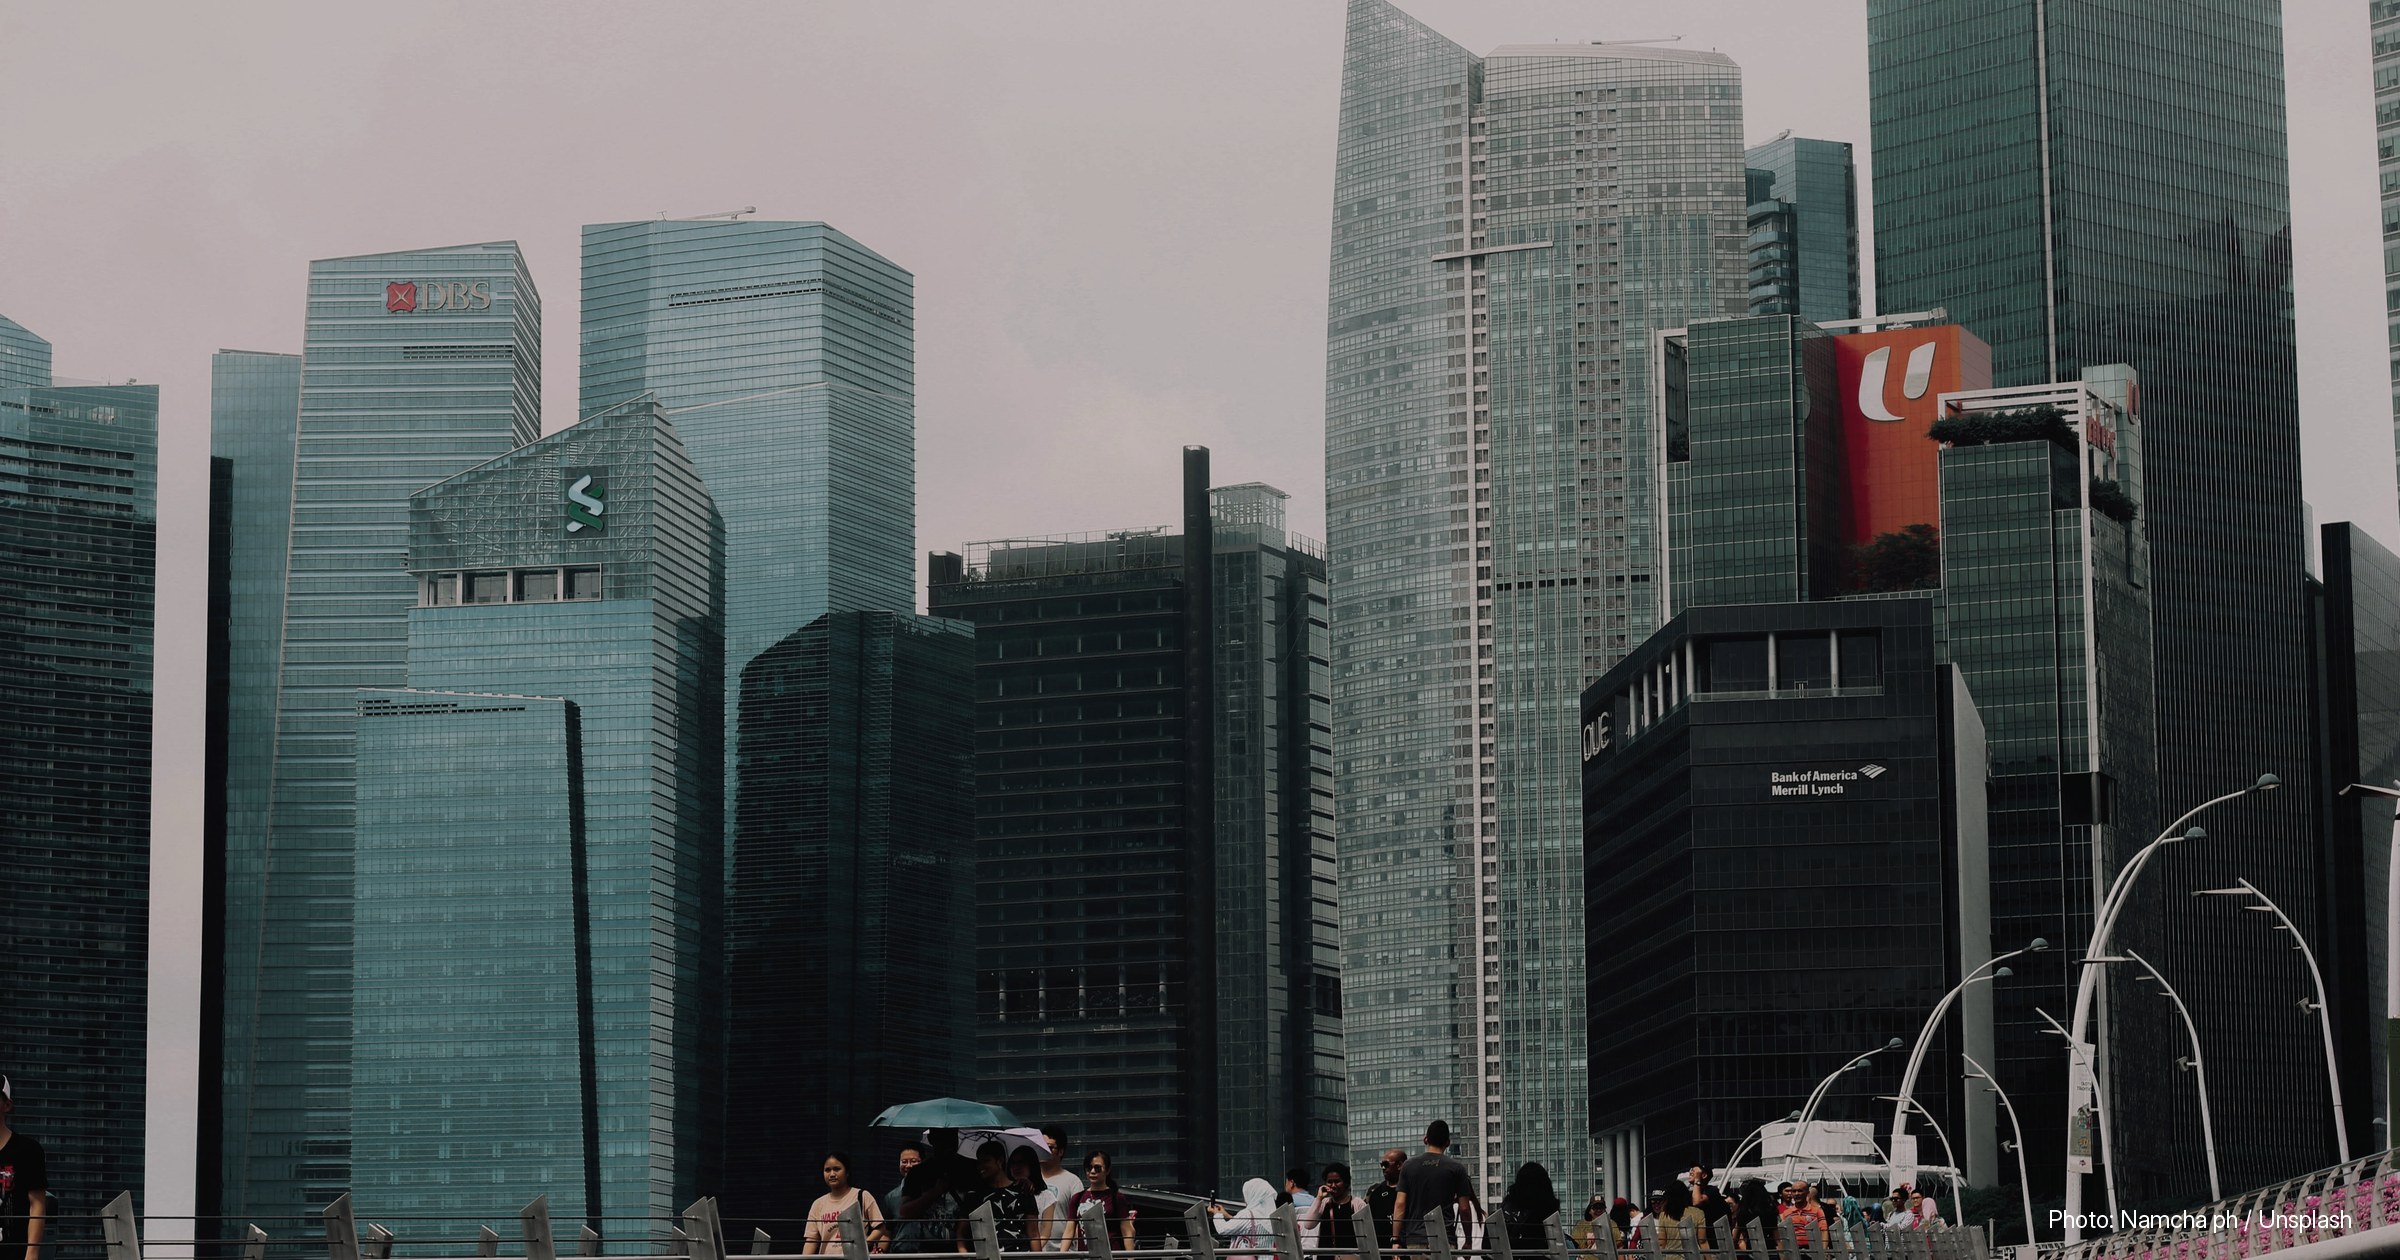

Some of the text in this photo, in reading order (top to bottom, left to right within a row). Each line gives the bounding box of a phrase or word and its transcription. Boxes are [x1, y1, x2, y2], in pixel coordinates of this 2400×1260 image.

[421, 282, 491, 310] DBS
[1583, 711, 1610, 762] OUE
[1771, 769, 1858, 783] Bank of America
[1771, 783, 1844, 797] Merrill Lynch
